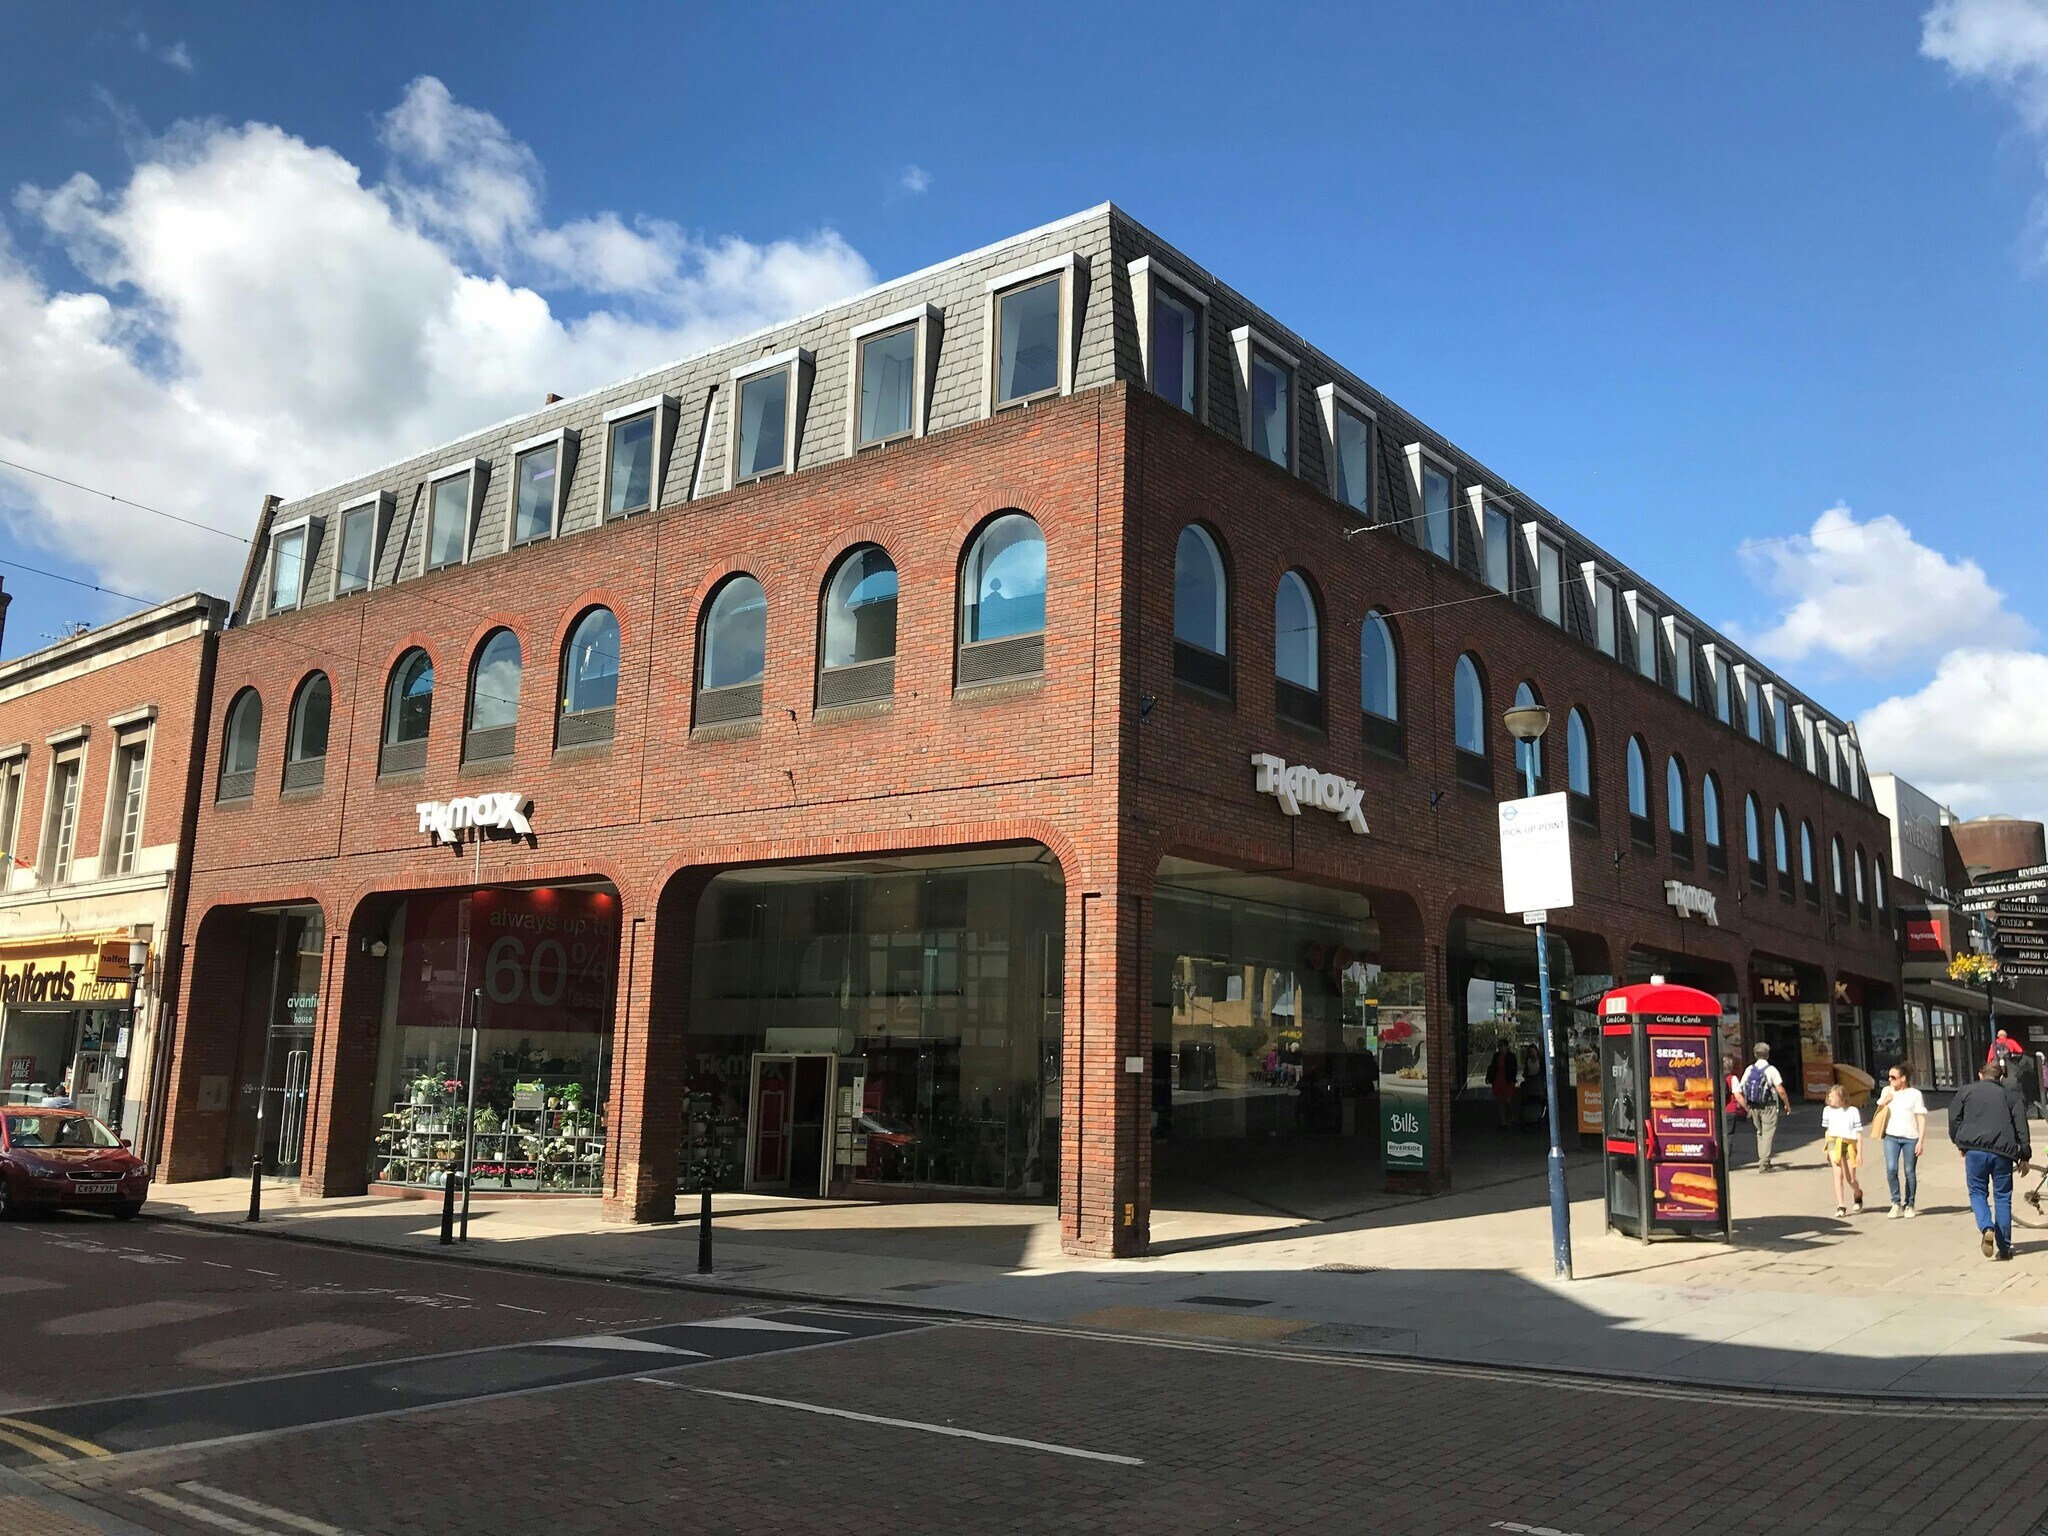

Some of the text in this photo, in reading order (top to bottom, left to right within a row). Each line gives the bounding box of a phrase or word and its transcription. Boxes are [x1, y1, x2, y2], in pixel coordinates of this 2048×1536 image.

[1525, 825, 1536, 833] UP
[1539, 820, 1564, 831] POINT
[1964, 879, 2047, 897] EDEN WALK SHOPPING
[489, 907, 611, 939] always up to
[2000, 918, 2025, 927] STATION
[2000, 935, 2044, 944] THE ROTUNDA
[2019, 951, 2040, 959] PARISH
[2018, 966, 2044, 975] LONDON
[0, 961, 75, 1001] halfords
[80, 979, 117, 1001] metro
[568, 986, 605, 1008] less
[293, 1013, 313, 1024] house
[1656, 1015, 1674, 1023] Coins
[1682, 1016, 1701, 1024] Cards
[1656, 1049, 1684, 1058] SEIZE
[12, 1061, 30, 1070] HALF
[1669, 1056, 1703, 1068] cheese
[11, 1070, 29, 1078] PRICE
[1612, 1066, 1622, 1077] BT
[1390, 1112, 1419, 1133] Bill's
[1389, 1144, 1421, 1152] RIVERSIDE
[1666, 1144, 1704, 1153] SUBWAY
